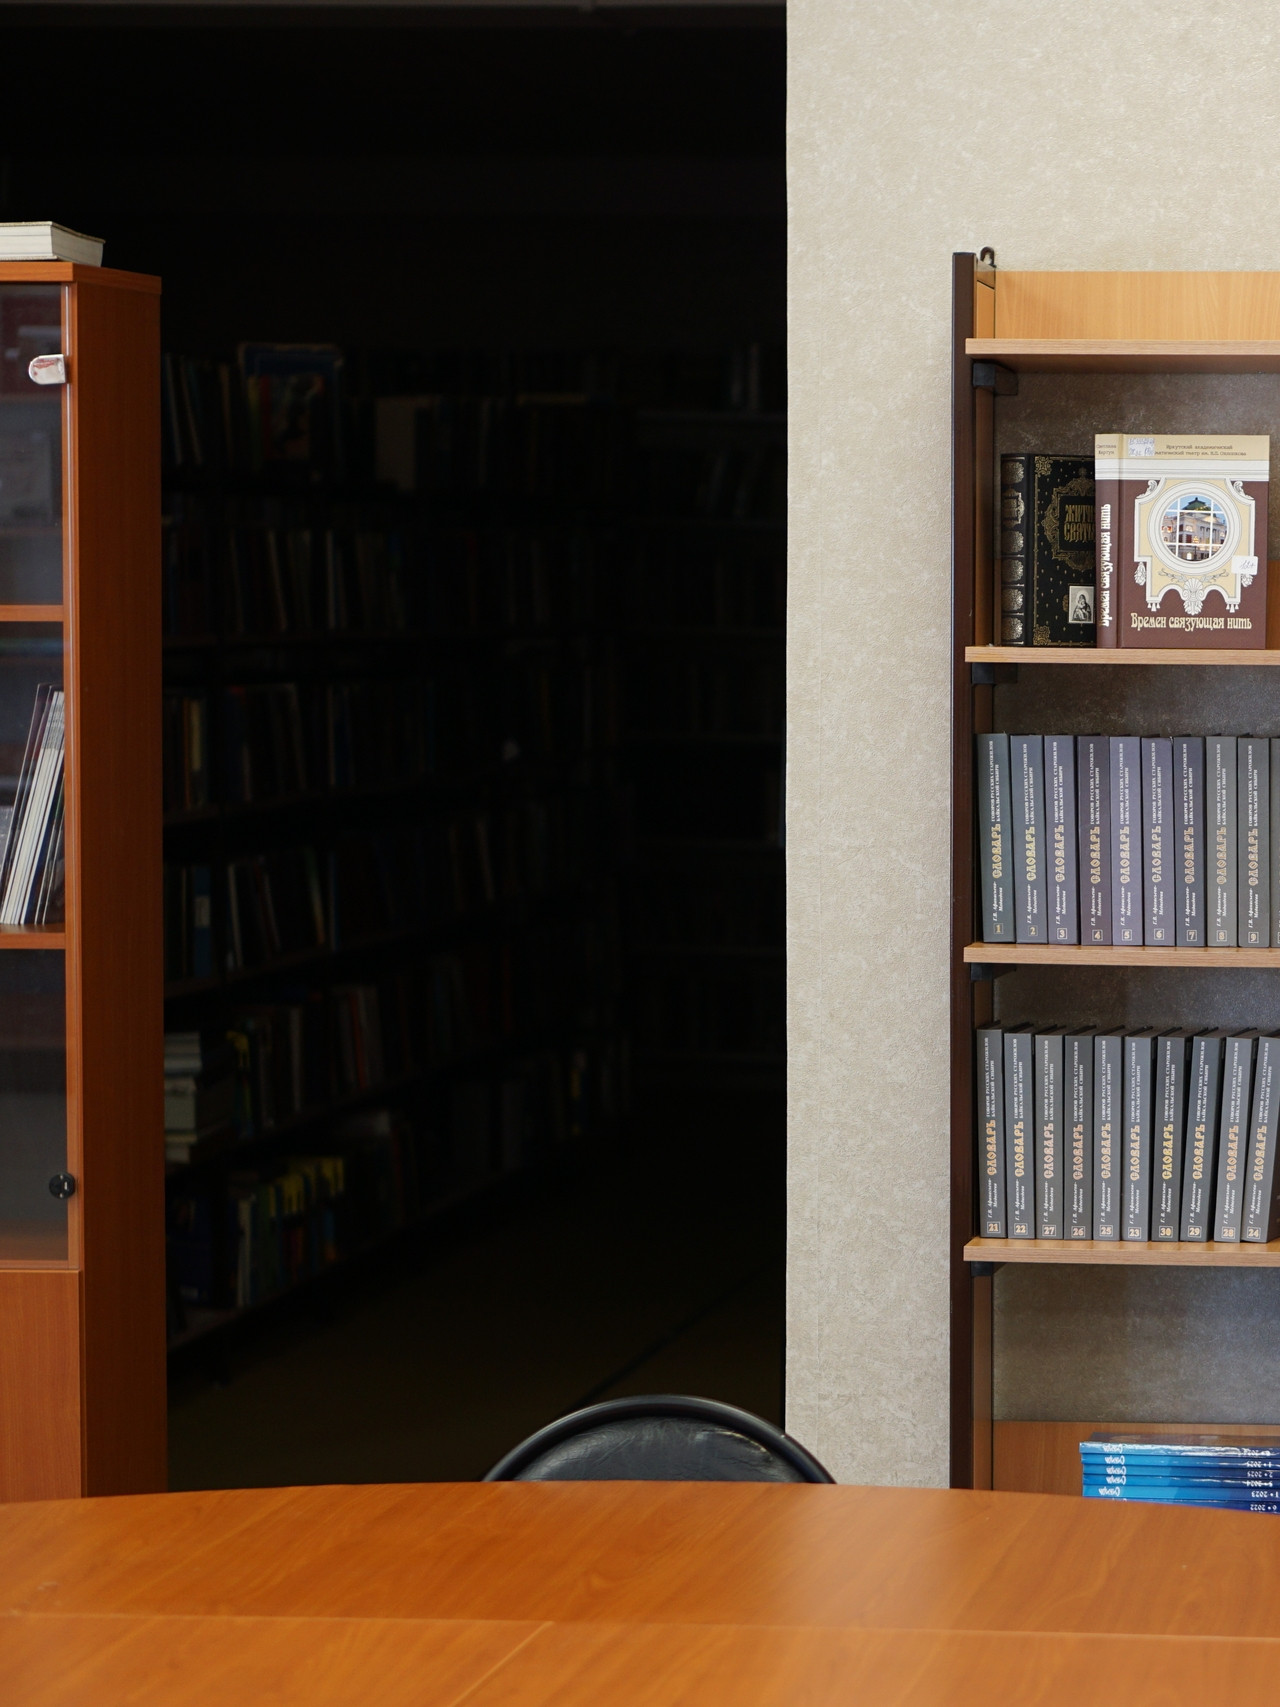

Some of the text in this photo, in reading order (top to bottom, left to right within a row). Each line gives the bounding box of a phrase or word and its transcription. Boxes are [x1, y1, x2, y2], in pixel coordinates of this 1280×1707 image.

[1130, 612, 1253, 632] Времен связующая нить
[991, 823, 1003, 880] СЛОВАРЬ
[1025, 825, 1037, 881] СЛОВАРЬ
[1054, 824, 1065, 883] СЛОВАРЬ
[1090, 825, 1102, 885] СЛОВАРЬ
[1120, 825, 1131, 884] СЛОВАРЬ
[1152, 825, 1162, 883] СЛОВАРЬ
[1184, 826, 1195, 885] СЛОВАРЬ
[1217, 826, 1227, 885] СЛОВАРЬ
[1248, 828, 1259, 887] СЛОВАРЬ
[986, 1119, 997, 1177] СЛОВАРЬ
[1014, 1120, 1025, 1178] СЛОВАРЬ
[1044, 1123, 1055, 1179] СЛОВАРЬ
[1073, 1123, 1084, 1181] СЛОВАРЬ
[1101, 1122, 1112, 1180] СЛОВАРЬ
[1130, 1124, 1141, 1182] СЛОВАРЬ
[1162, 1123, 1174, 1181] СЛОВАРЬ
[1192, 1123, 1206, 1181] СЛОВАРЬ
[1226, 1124, 1239, 1182] СЛОВАРЬ
[1253, 1124, 1268, 1182] СЛОВАРЬ
[988, 1223, 999, 1233] 21
[1015, 1224, 1026, 1234] 22
[1043, 1226, 1055, 1235] 27
[1072, 1227, 1084, 1236] 26
[1100, 1226, 1112, 1235] 25
[1129, 1228, 1140, 1237] 23
[1160, 1227, 1171, 1236] 30
[1189, 1227, 1200, 1236] 29
[1223, 1228, 1234, 1238] 28
[1248, 1228, 1259, 1238] 24
[1250, 1490, 1268, 1498] 2023
